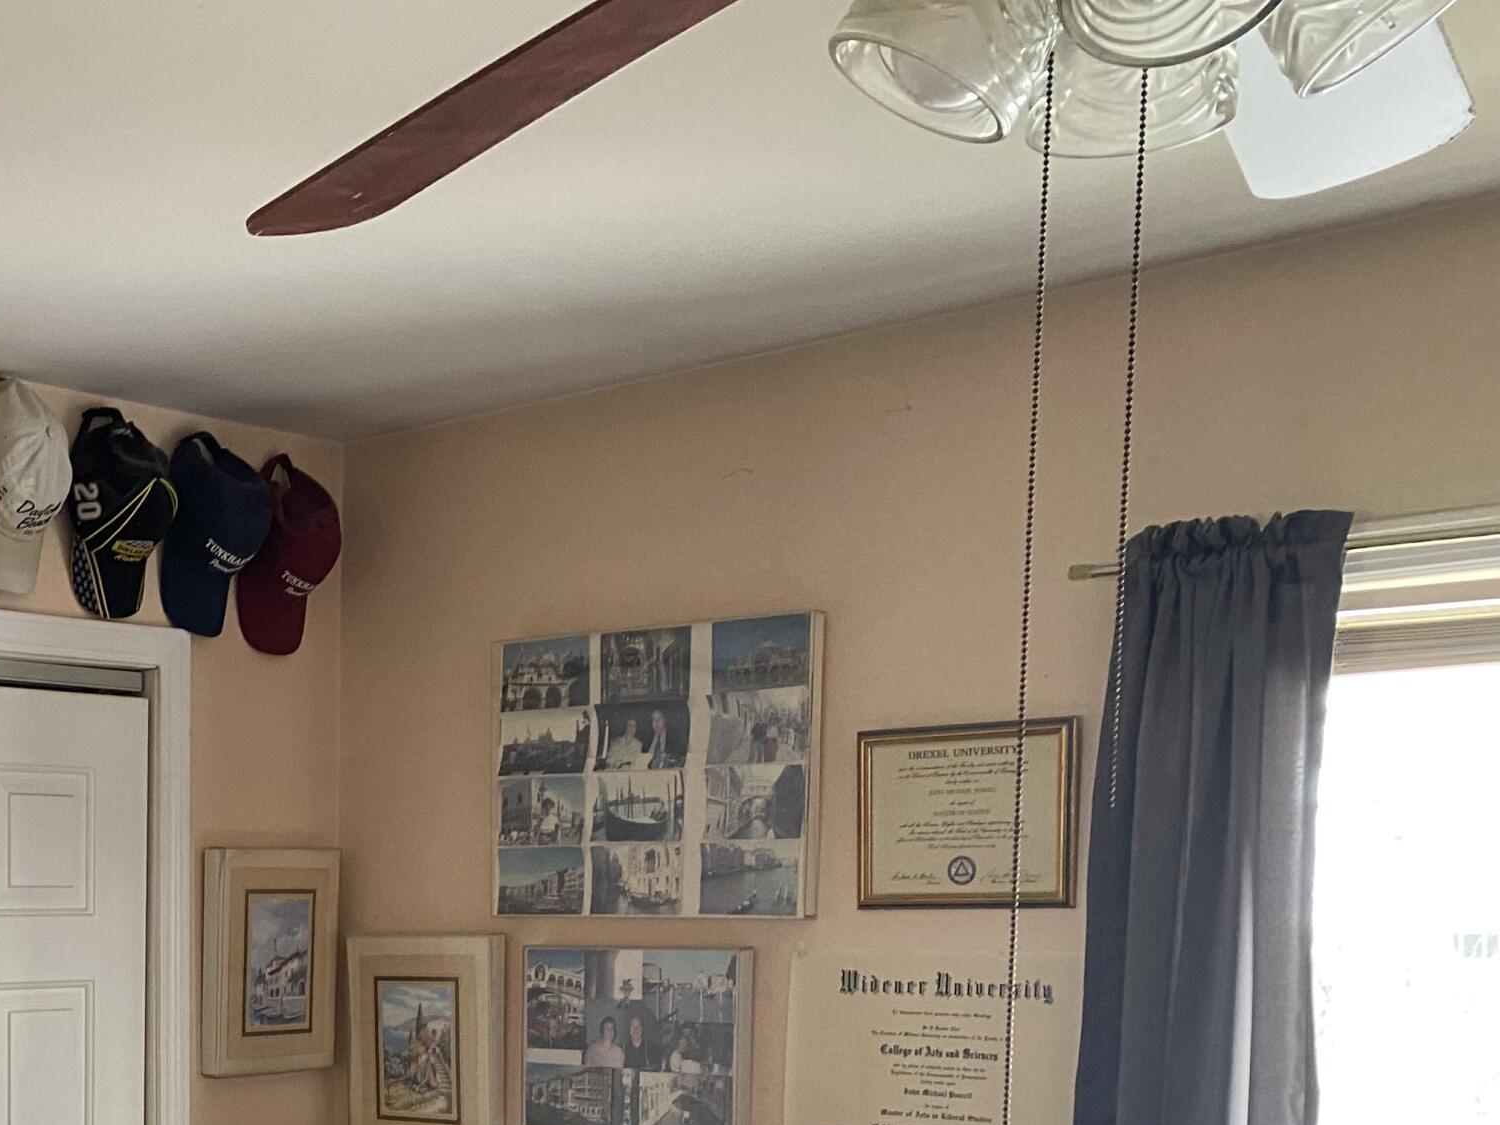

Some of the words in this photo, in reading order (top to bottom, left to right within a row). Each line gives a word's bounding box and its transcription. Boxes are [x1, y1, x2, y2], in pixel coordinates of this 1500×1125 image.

[74, 482, 102, 520] 20
[908, 749, 948, 760] DREXEL
[953, 745, 1018, 757] UNIVERSITY
[840, 968, 928, 996] Widener
[880, 1043, 912, 1058] College
[914, 1047, 923, 1056] of
